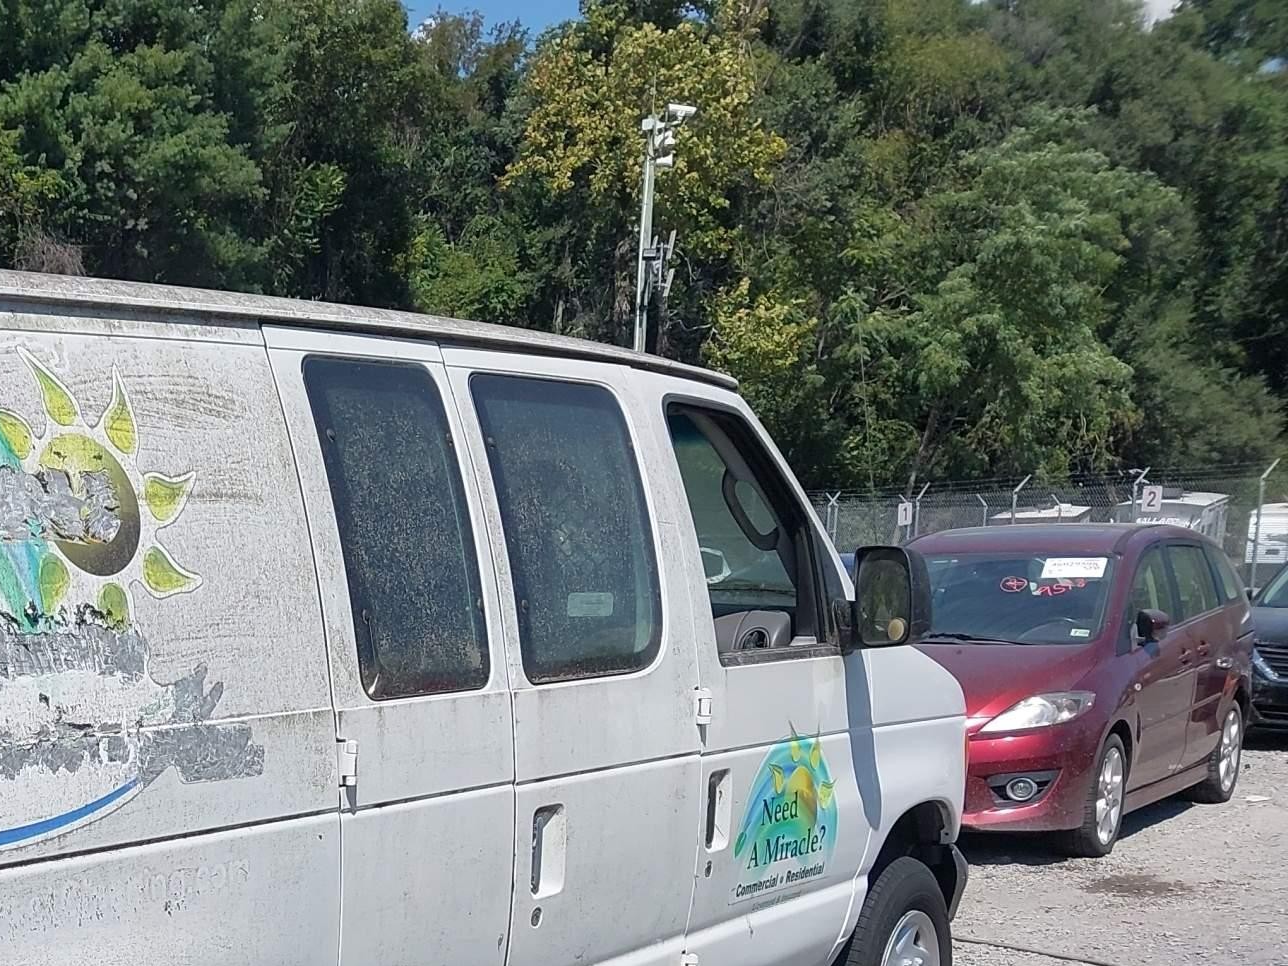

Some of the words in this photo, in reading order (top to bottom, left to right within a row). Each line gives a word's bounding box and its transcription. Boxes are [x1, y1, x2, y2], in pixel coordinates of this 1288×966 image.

[1146, 491, 1156, 507] 2
[761, 791, 798, 826] Need
[747, 842, 759, 869] A
[763, 826, 826, 866] Miracle?
[736, 877, 778, 897] Commercial
[785, 862, 825, 883] Residential
